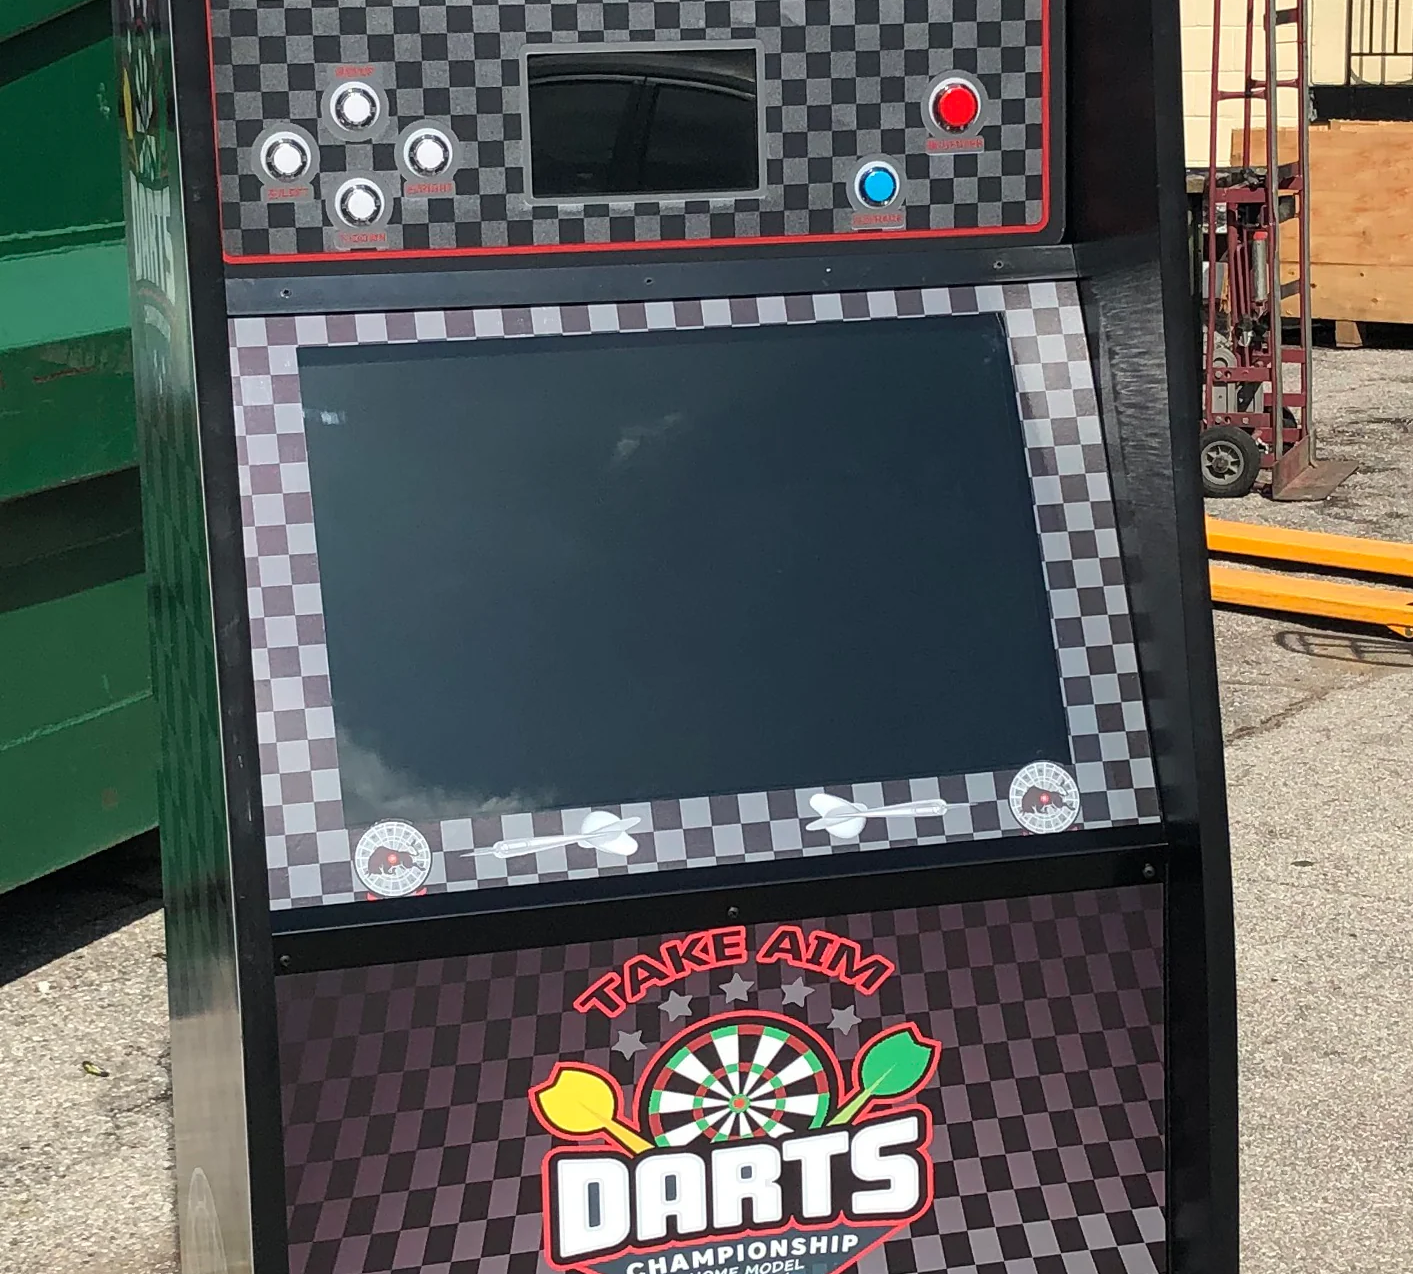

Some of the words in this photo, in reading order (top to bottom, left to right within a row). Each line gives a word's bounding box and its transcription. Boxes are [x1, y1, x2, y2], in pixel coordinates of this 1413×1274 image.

[573, 925, 748, 1018] TAKE
[756, 924, 895, 997] AIM
[556, 1116, 920, 1259] DARTS
